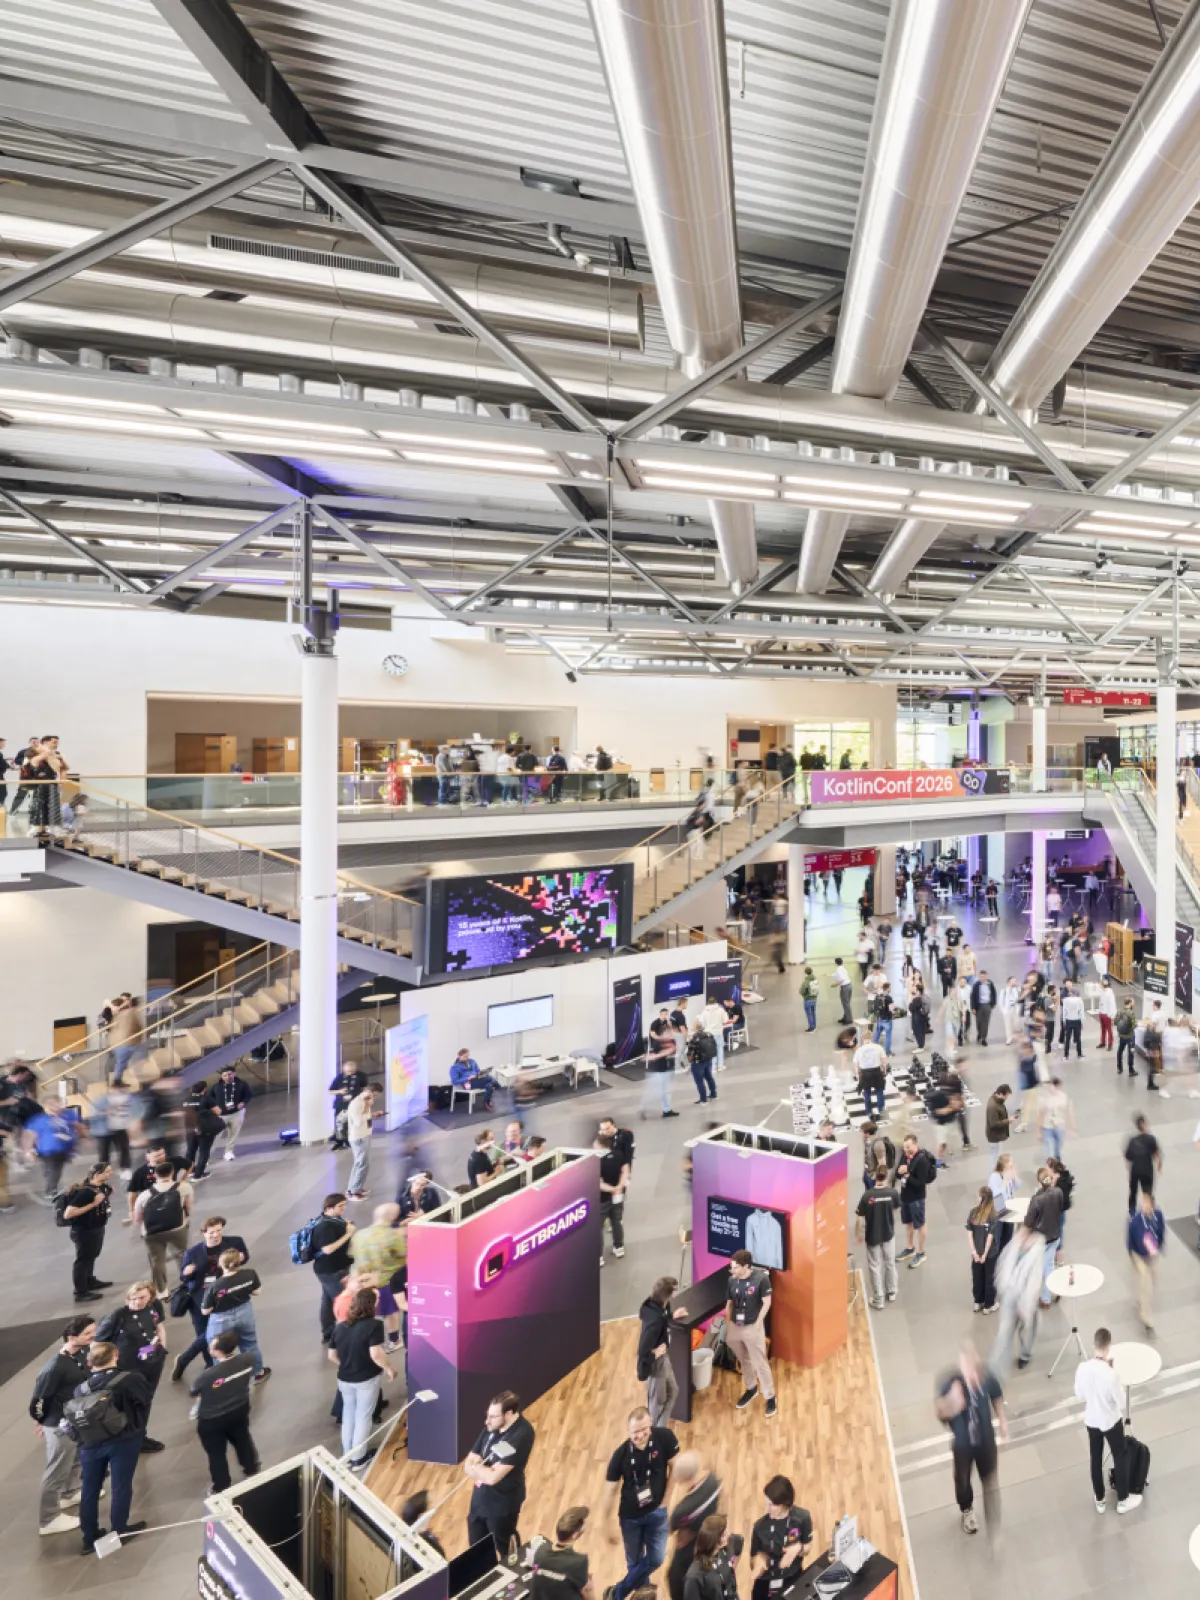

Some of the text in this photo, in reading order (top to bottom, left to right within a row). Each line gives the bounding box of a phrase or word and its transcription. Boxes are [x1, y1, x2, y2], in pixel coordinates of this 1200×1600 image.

[824, 775, 953, 796] KotlinConf 2026
[513, 1203, 587, 1260] JETBRAINS
